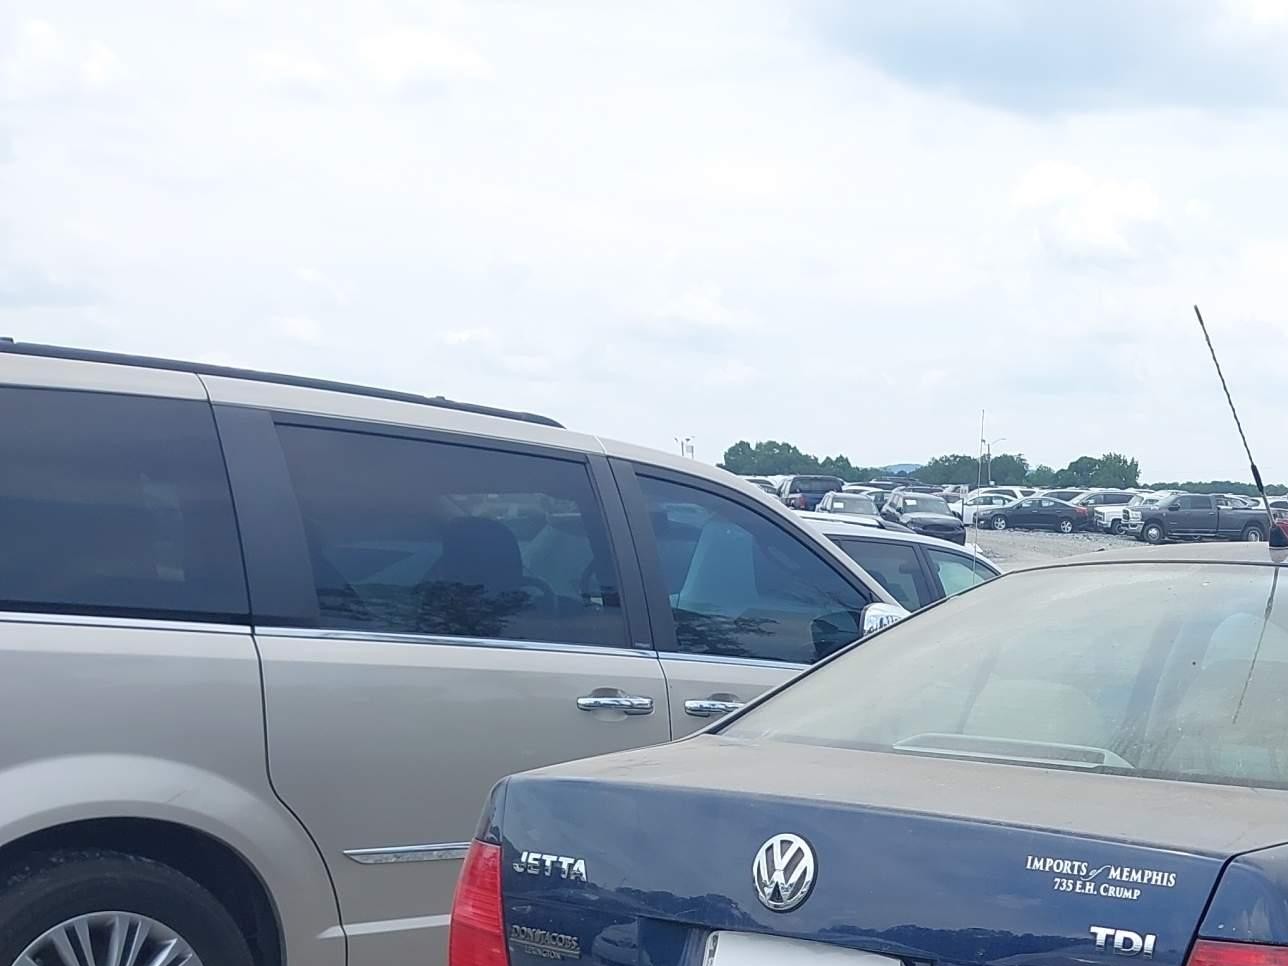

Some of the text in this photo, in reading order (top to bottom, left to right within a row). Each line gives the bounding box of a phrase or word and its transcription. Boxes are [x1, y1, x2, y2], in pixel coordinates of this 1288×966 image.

[512, 851, 588, 882] JETTA
[1025, 855, 1177, 887] IMPORTS of MEMPHIS
[1053, 878, 1073, 892] 735
[1075, 881, 1098, 895] E.H.
[1089, 926, 1156, 959] TDI
